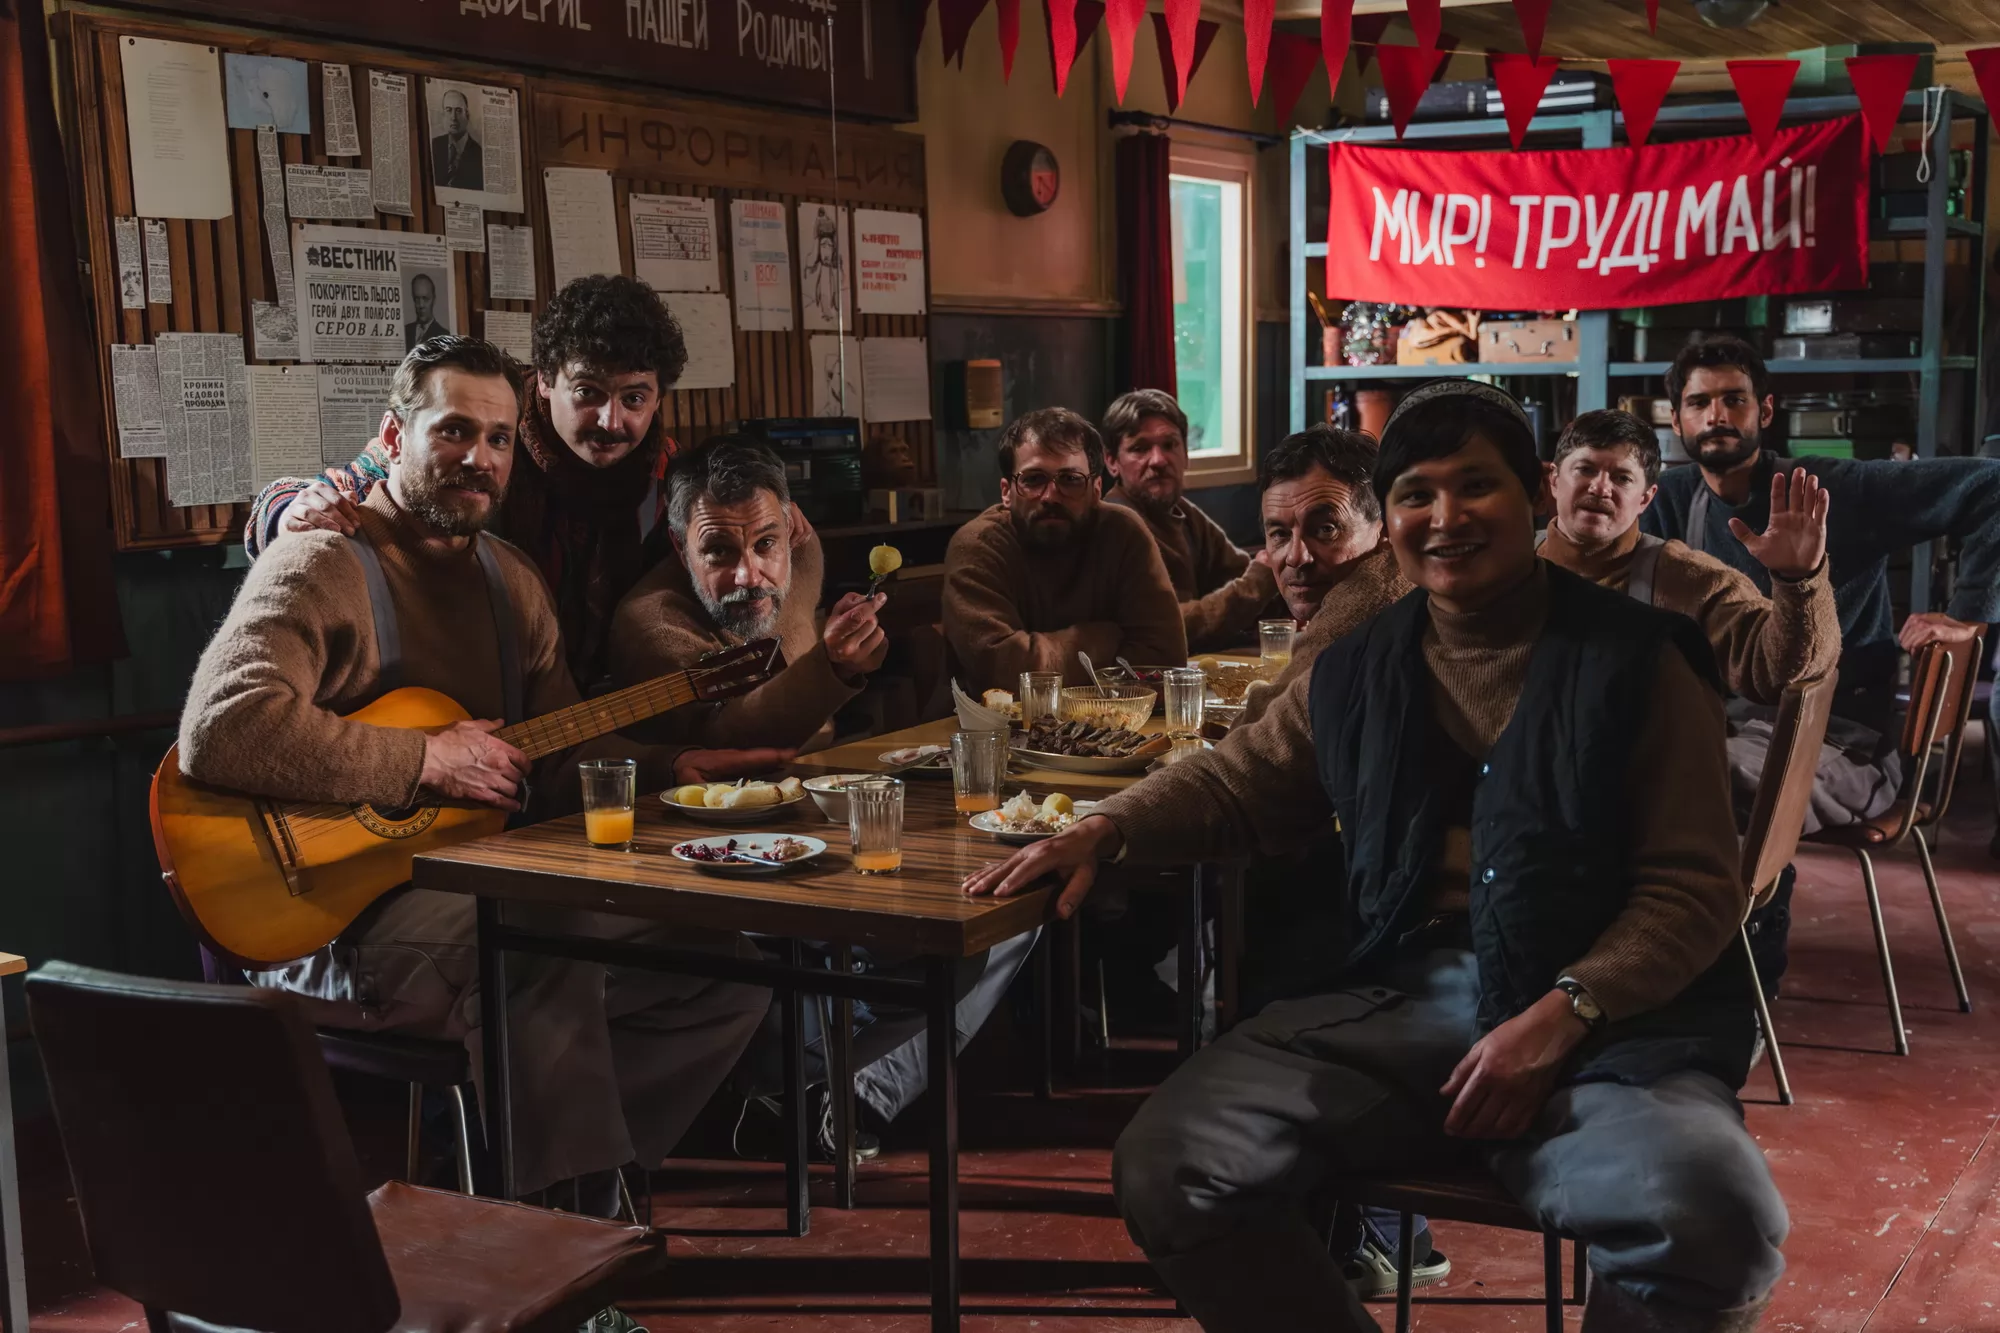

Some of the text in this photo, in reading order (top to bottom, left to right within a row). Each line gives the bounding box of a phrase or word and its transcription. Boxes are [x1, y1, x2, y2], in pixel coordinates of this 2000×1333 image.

[557, 110, 920, 190] ИНФОРМАЦИЯ
[1369, 156, 1818, 276] МИР! ТРУД! МАЙ!
[320, 245, 398, 272] ВЕСТНИК
[309, 283, 401, 306] ПОКОРИТЕЛЬ ЛЬДОВ
[311, 302, 401, 321] ГЕРОЙ ДВУХ ПОЛЮСОВ
[315, 321, 400, 338] СЕРОВ А.В.
[183, 381, 225, 390] ХРОНИКА
[334, 376, 391, 386] СООБЩЕНИ
[184, 390, 225, 400] ЛЕДОВОЙ
[184, 399, 226, 409] ПРОВОДКИ
